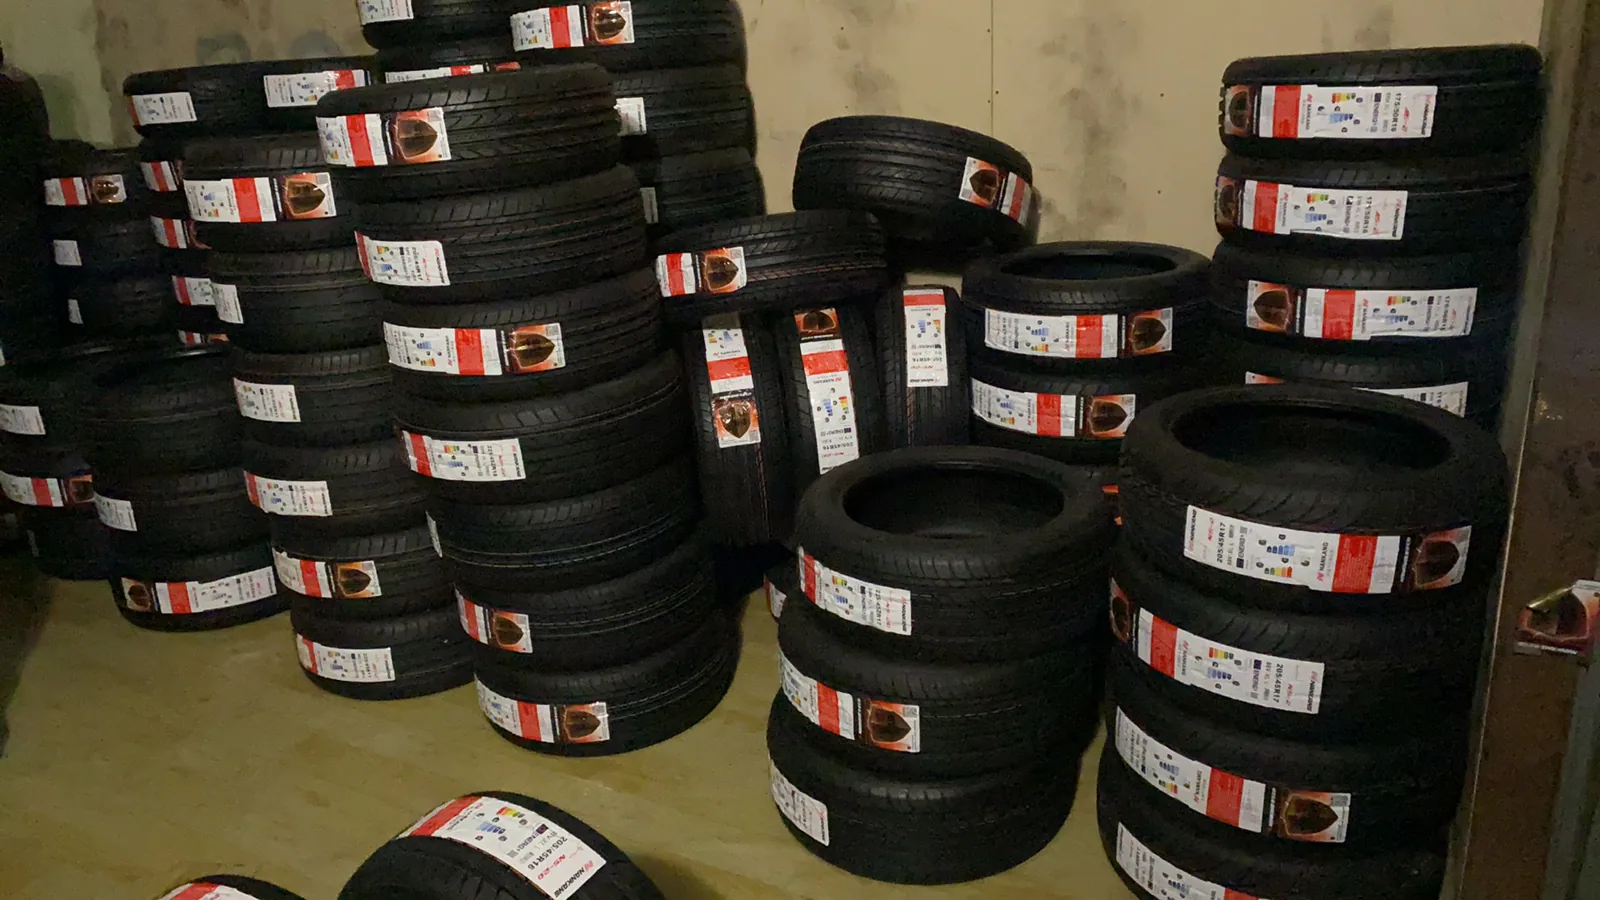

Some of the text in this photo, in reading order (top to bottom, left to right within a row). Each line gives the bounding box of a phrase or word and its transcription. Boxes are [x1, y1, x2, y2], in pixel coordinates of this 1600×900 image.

[1217, 522, 1226, 563] 205/45R17
[1319, 542, 1328, 571] NANKANG
[1273, 664, 1283, 703] 205/45R17
[527, 836, 568, 871] 205/45R16
[553, 866, 586, 898] NANKANG
